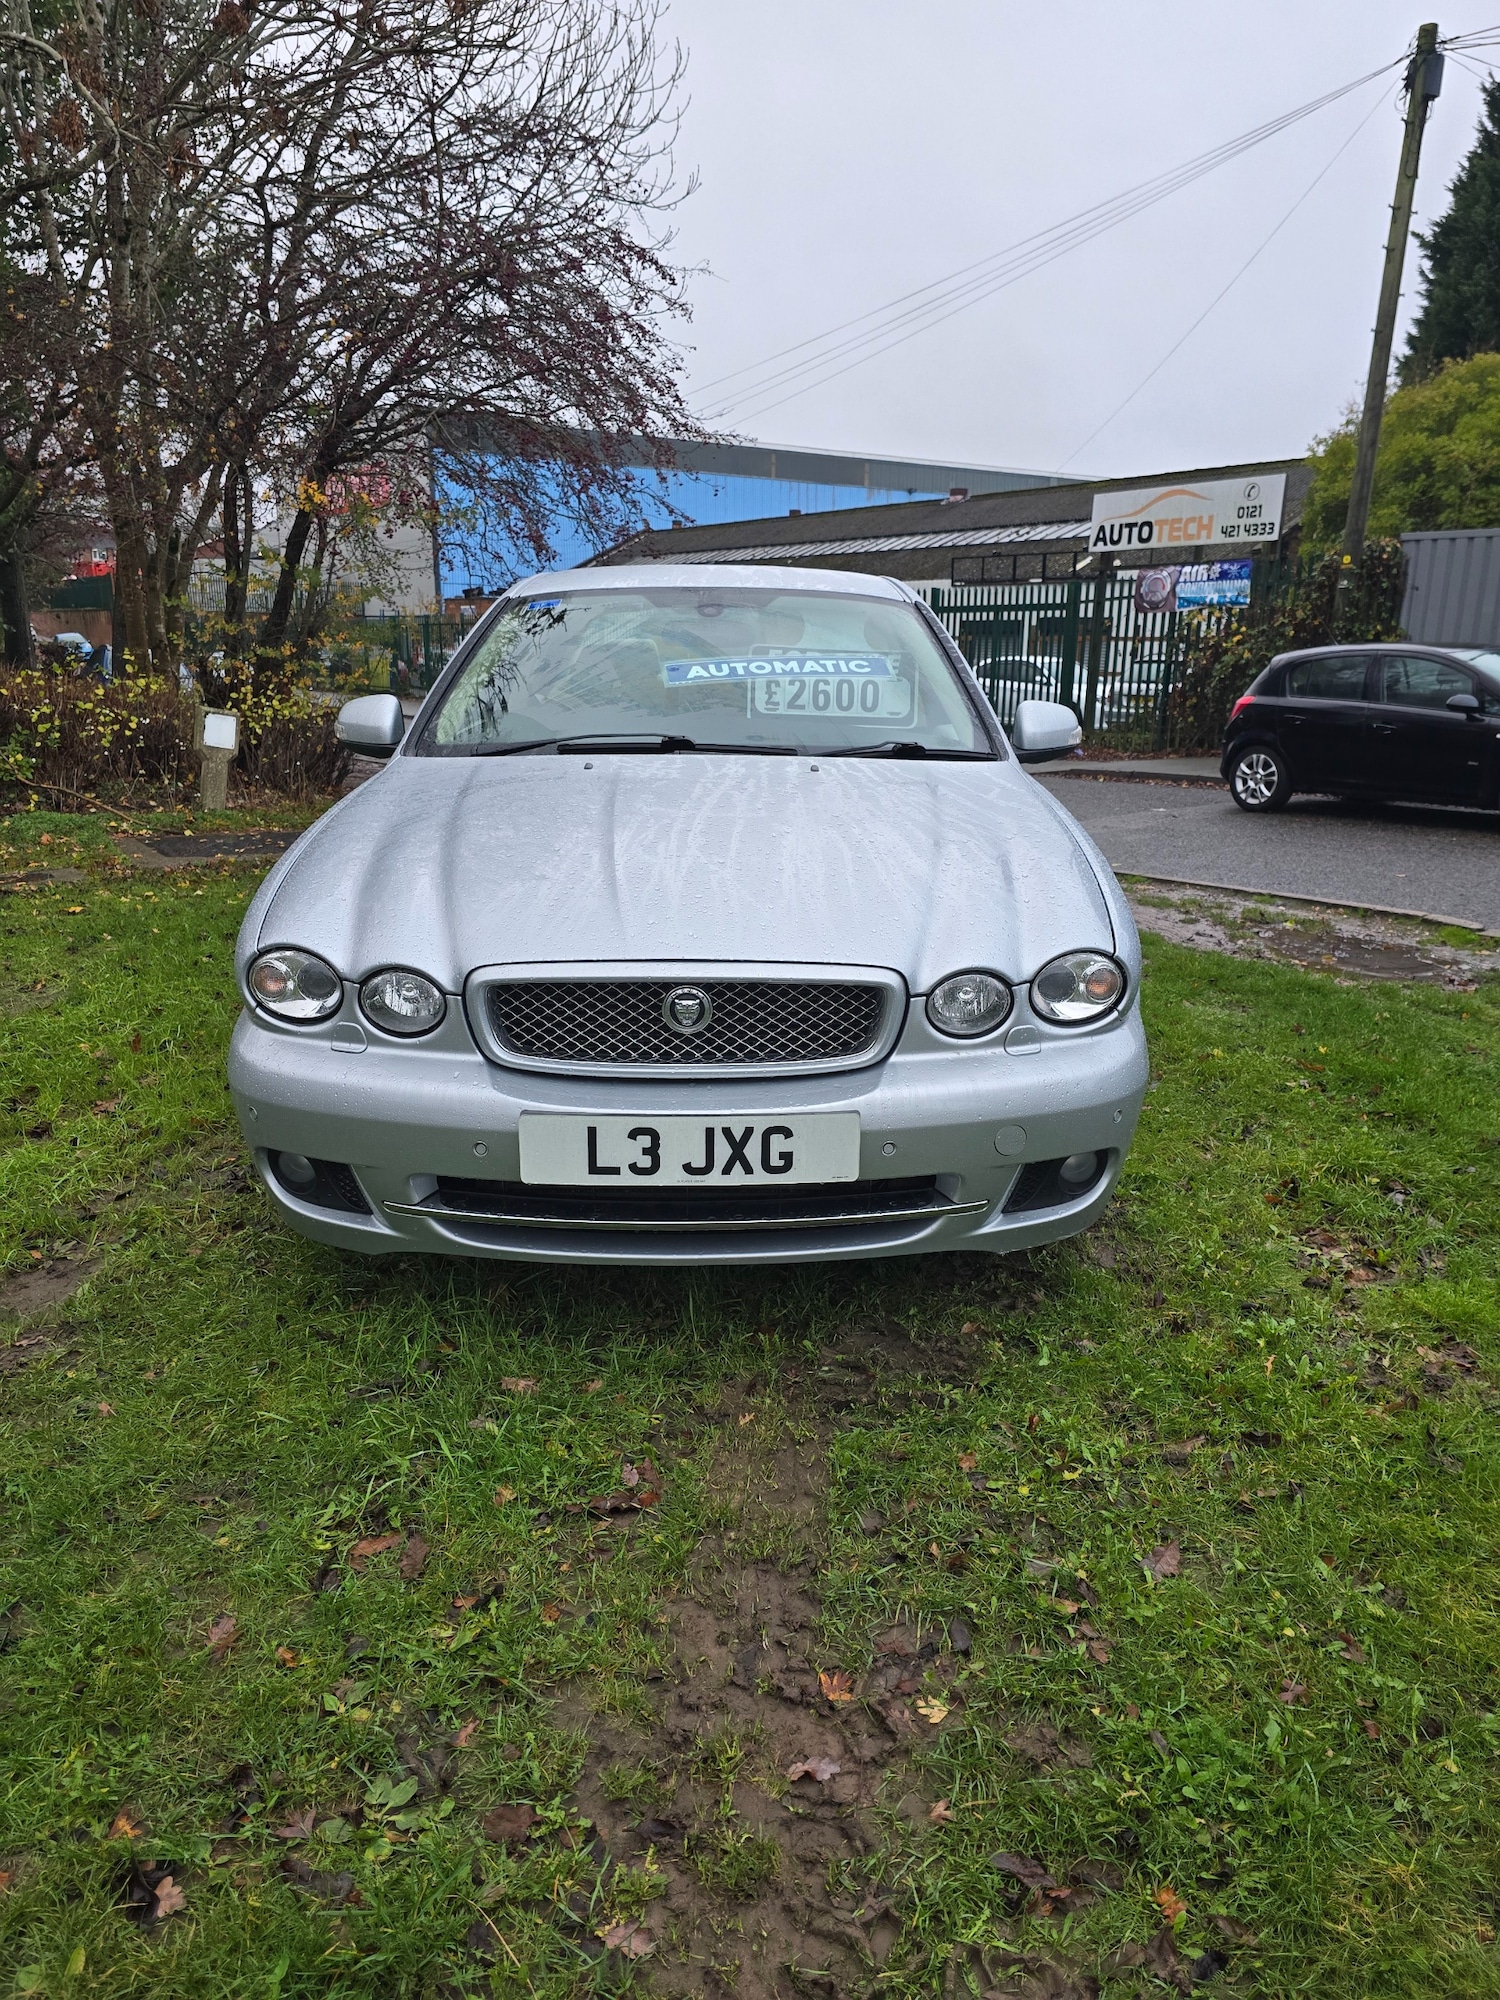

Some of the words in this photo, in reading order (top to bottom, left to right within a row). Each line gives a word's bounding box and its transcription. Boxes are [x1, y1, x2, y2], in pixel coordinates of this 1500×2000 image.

[1236, 505, 1262, 519] 0121
[1221, 524, 1241, 539] 421
[1244, 522, 1275, 537] 4333
[1179, 564, 1209, 582] AIR
[686, 659, 872, 680] AUTOMATIC
[764, 678, 880, 713] £2600
[587, 1126, 661, 1176] L3
[682, 1125, 795, 1176] JXG
